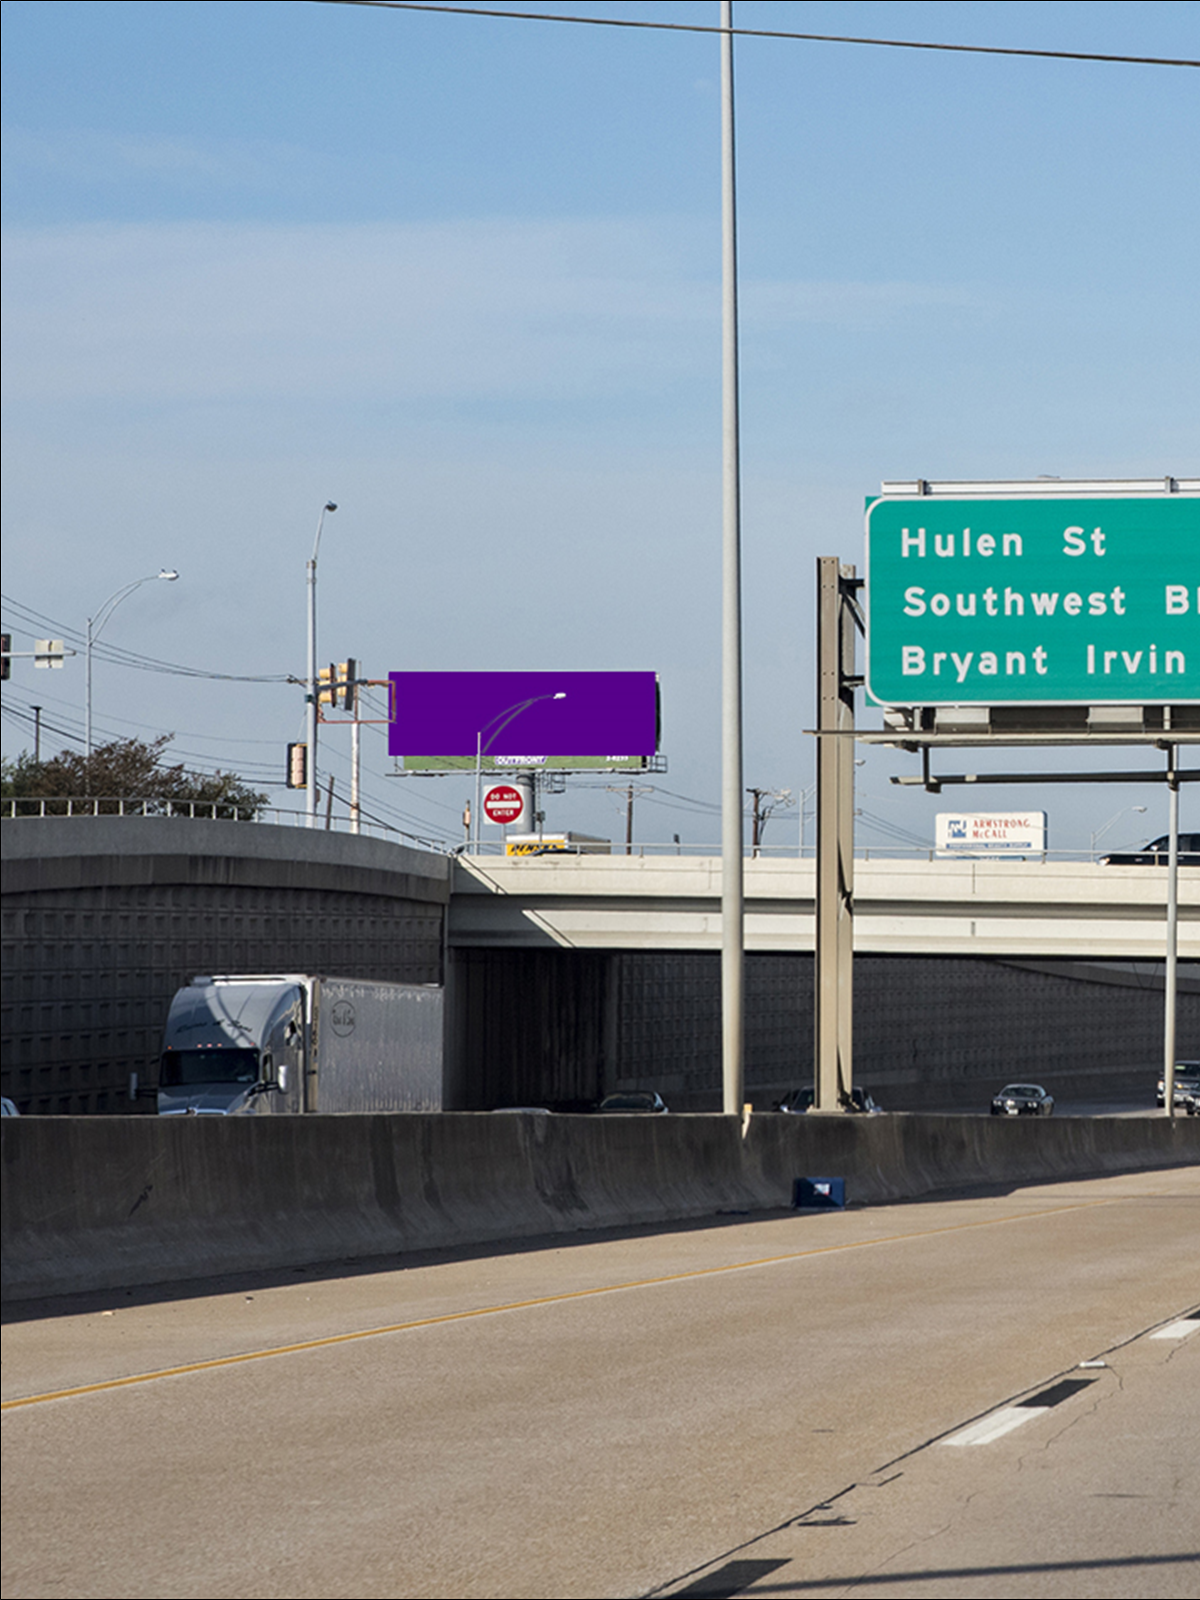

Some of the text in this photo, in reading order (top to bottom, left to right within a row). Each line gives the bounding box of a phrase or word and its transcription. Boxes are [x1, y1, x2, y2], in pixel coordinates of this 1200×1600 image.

[901, 527, 1023, 558] Hulen
[1062, 525, 1107, 557] St
[902, 585, 1126, 617] Southwest
[901, 644, 1048, 683] Bryant
[1086, 643, 1185, 675] Irvin
[490, 793, 501, 801] DO
[492, 809, 515, 817] ENTER
[972, 818, 1031, 829] ARMSTRONG
